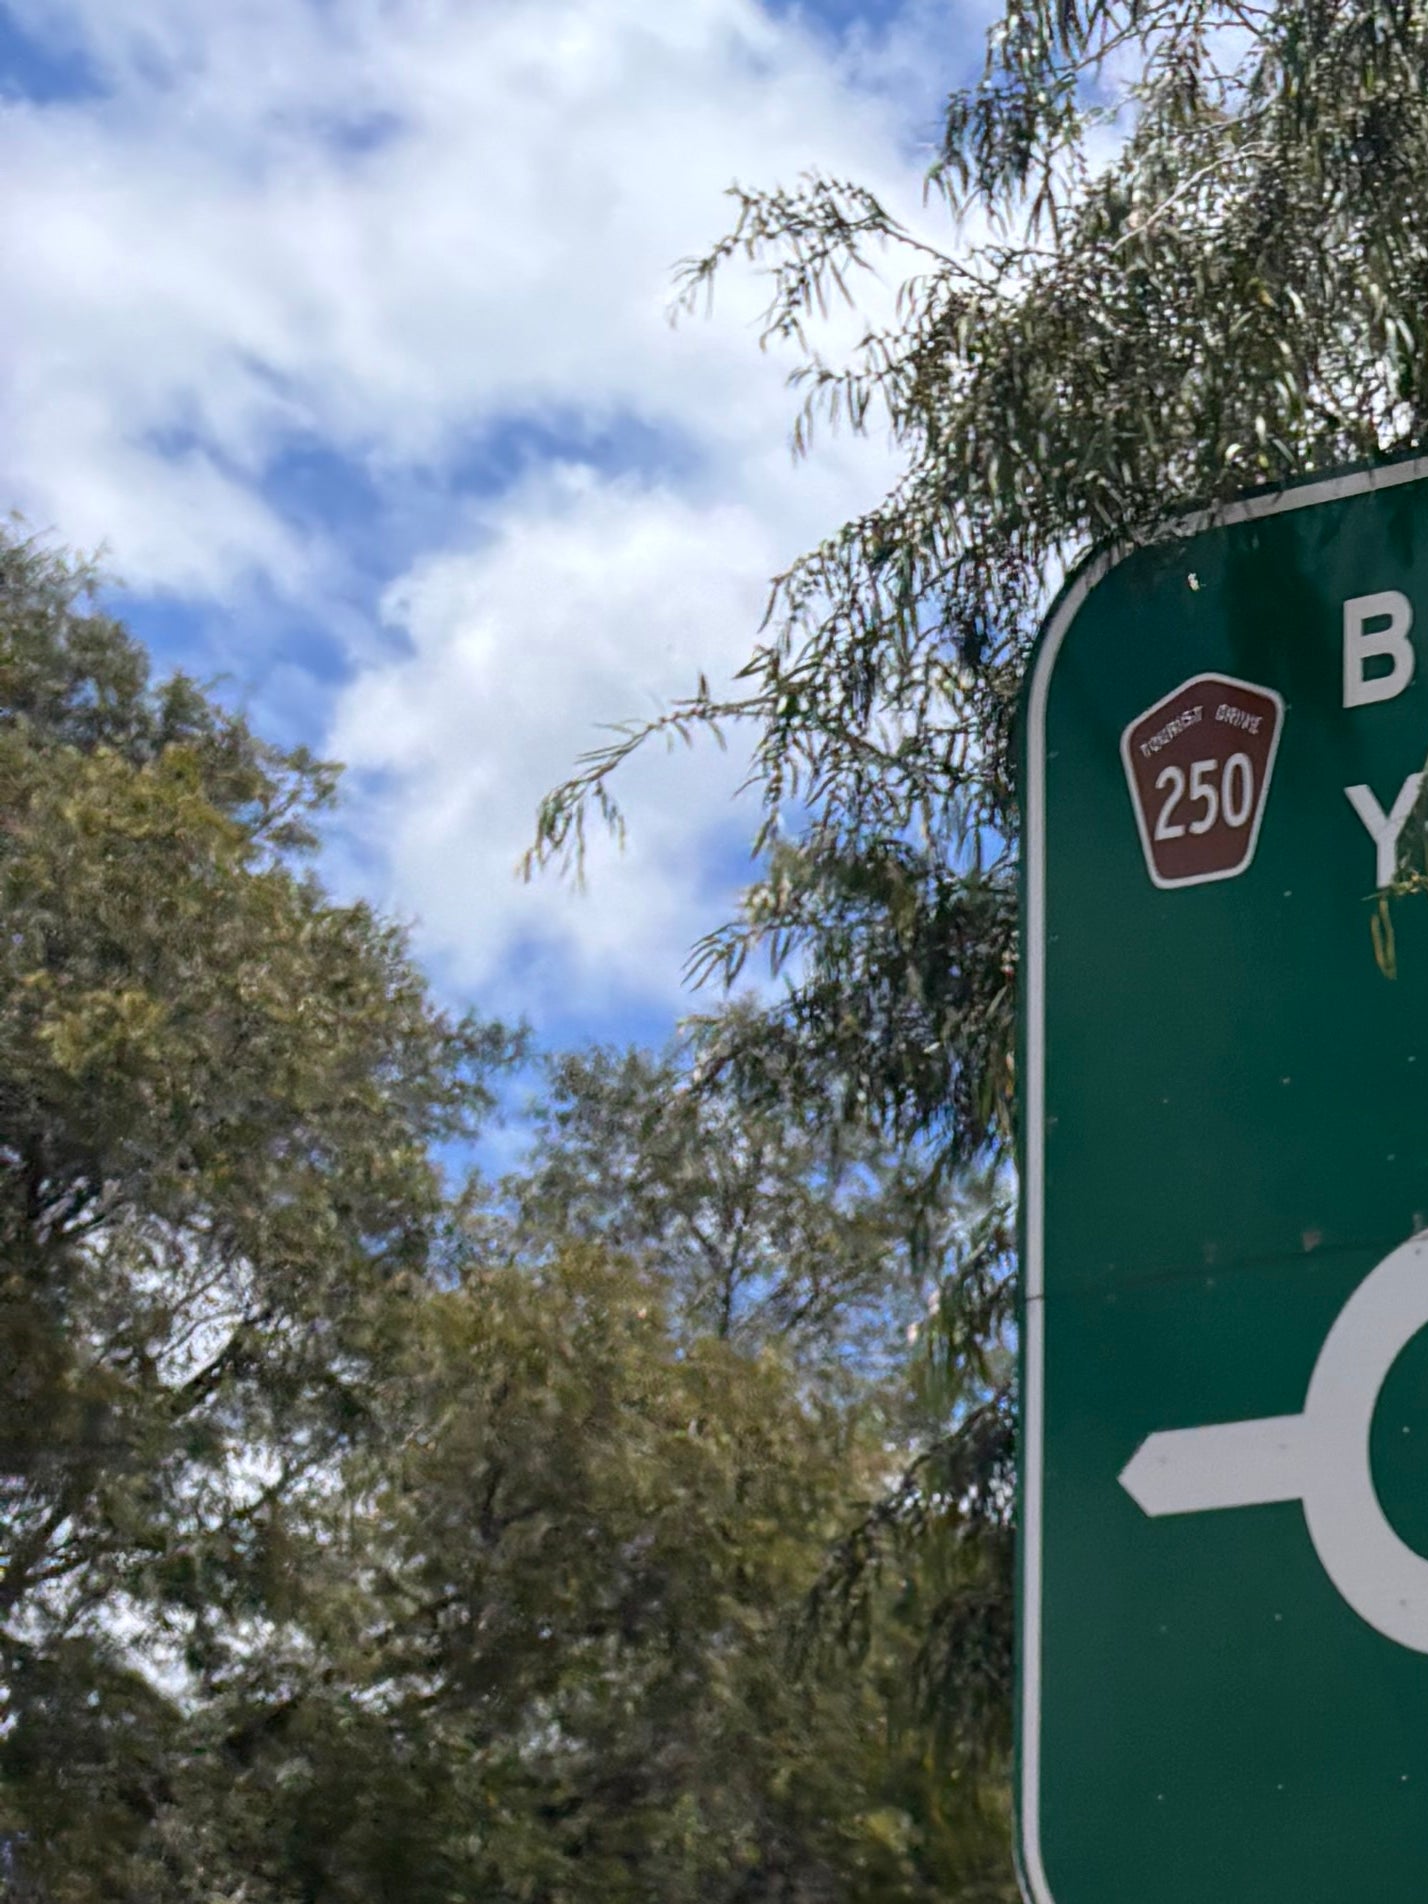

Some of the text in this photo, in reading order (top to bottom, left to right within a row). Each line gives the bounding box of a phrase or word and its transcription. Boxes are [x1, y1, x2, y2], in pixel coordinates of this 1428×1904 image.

[1139, 703, 1264, 759] TOURIST DRIVE
[1154, 751, 1255, 842] 250
